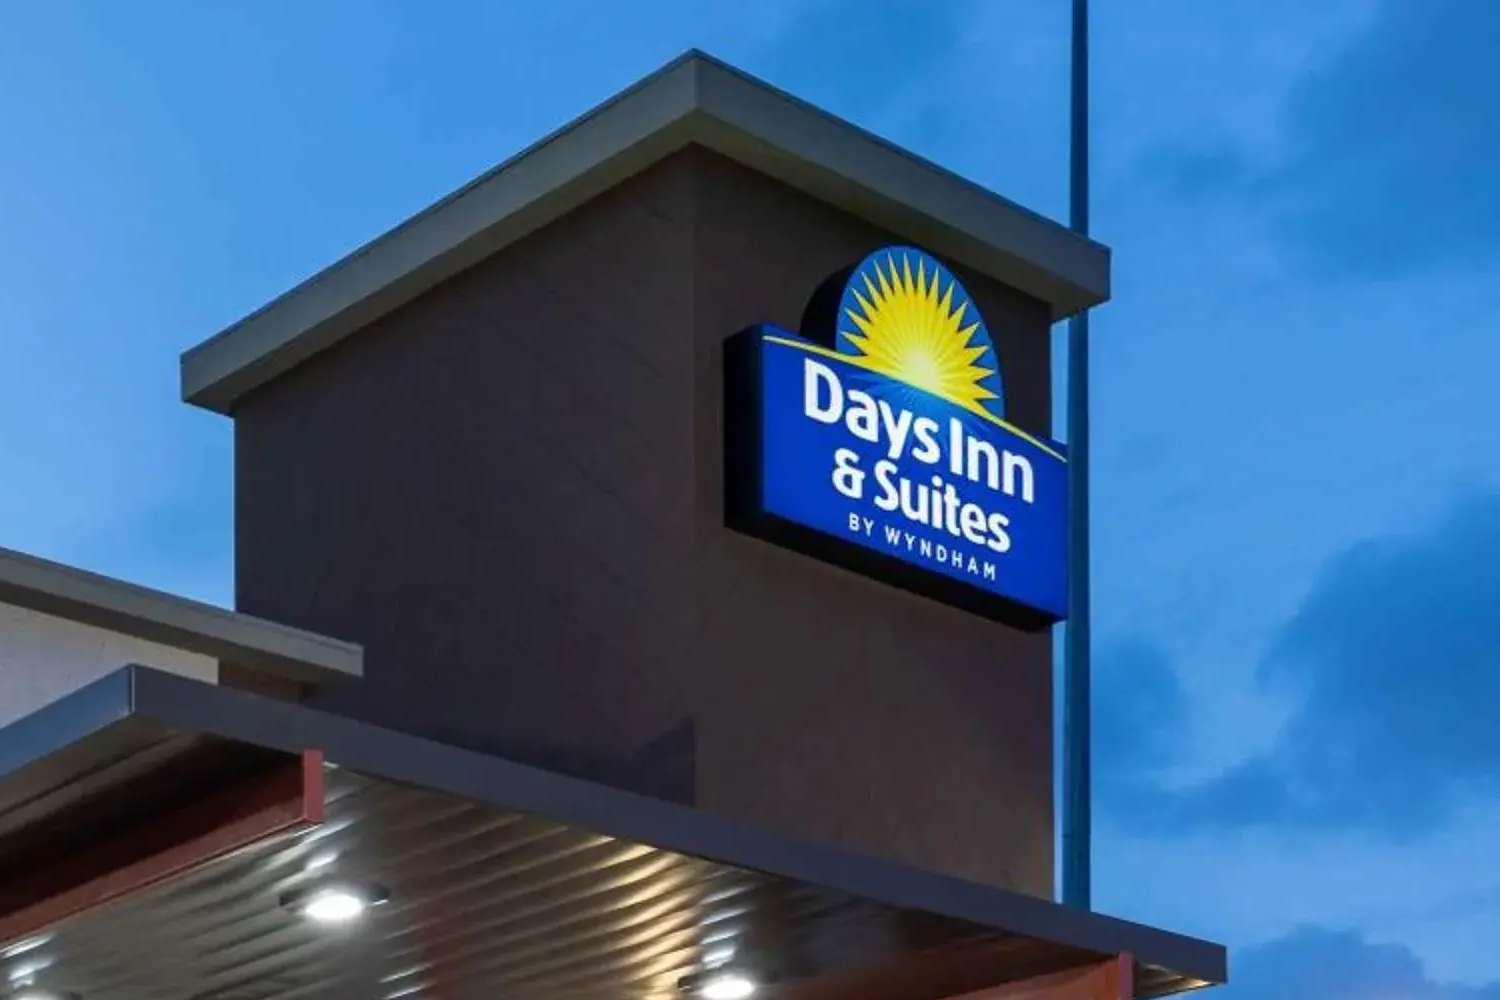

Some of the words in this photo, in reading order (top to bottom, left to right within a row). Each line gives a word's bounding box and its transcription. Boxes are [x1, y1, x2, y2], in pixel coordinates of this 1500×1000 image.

[804, 358, 941, 464] Days
[949, 416, 1034, 504] Inn
[832, 448, 865, 499] &
[873, 460, 1011, 553] Suites
[848, 513, 874, 537] BY
[884, 524, 997, 581] WYNDHAM
